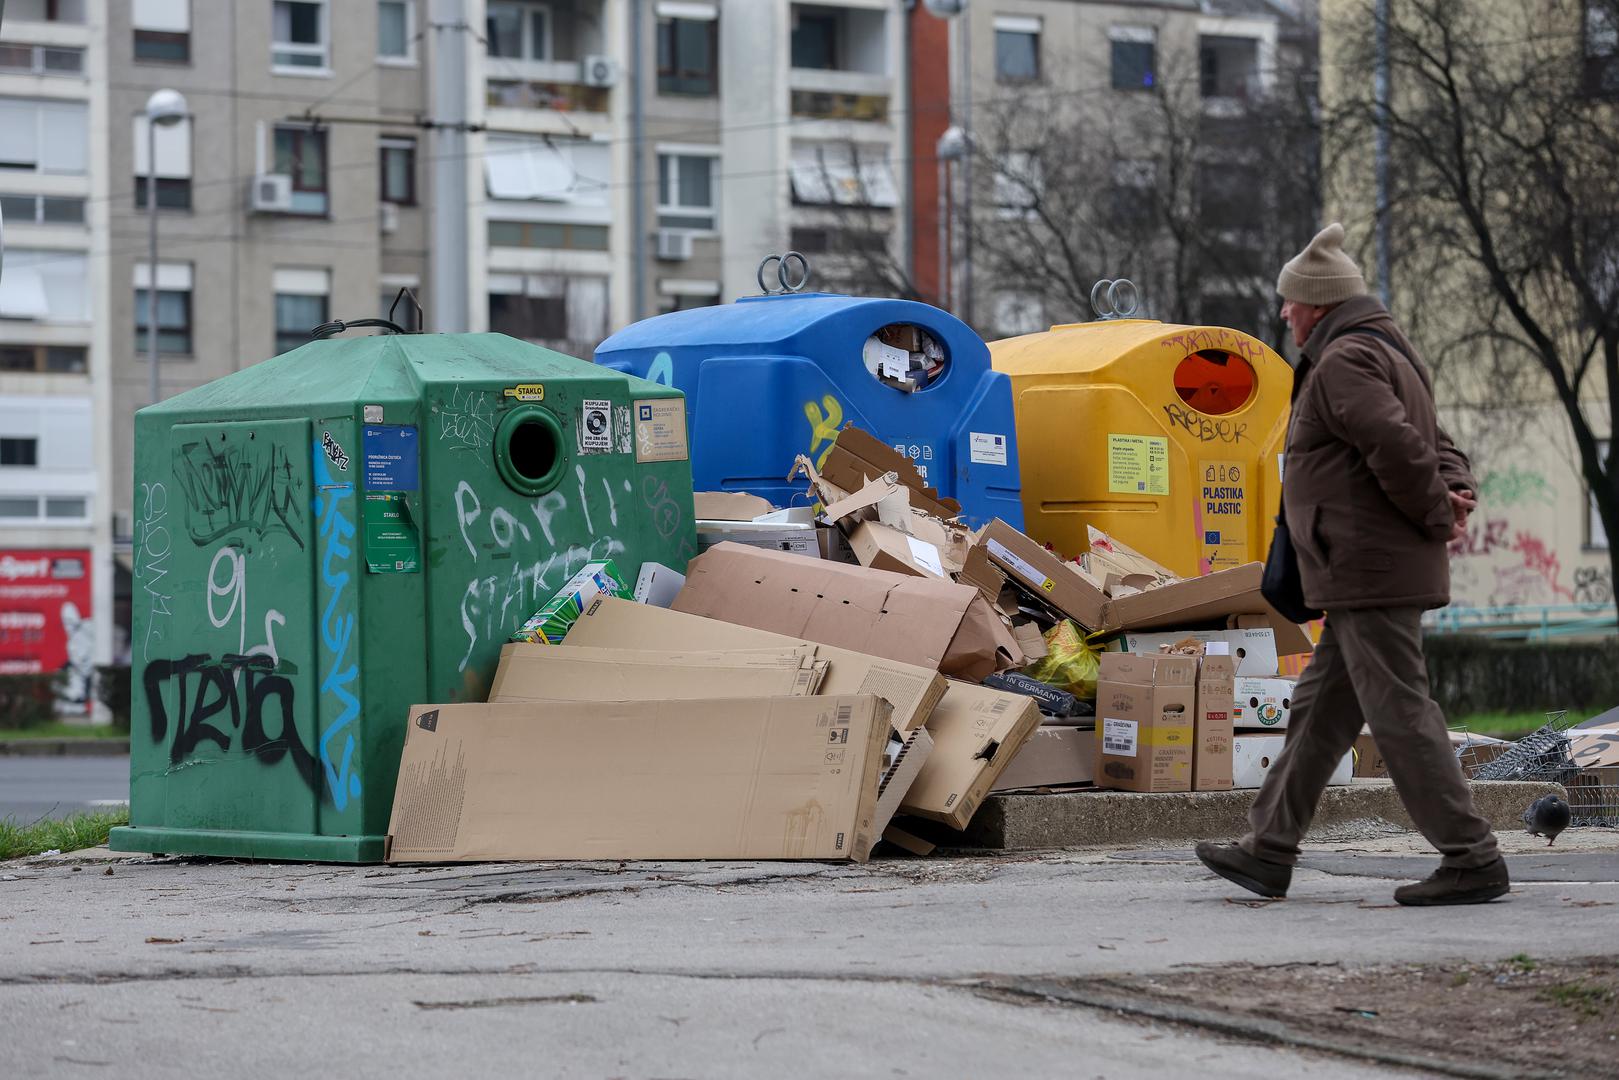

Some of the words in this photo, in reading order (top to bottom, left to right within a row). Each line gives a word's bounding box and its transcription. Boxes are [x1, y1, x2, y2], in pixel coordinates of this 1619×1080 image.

[518, 387, 542, 395] STAKLO
[1203, 487, 1244, 499] PLASTIKA
[1207, 502, 1241, 515] PLASTIC
[1045, 582, 1053, 590] 2
[1006, 675, 1017, 685] IN
[1018, 680, 1062, 703] GERMANY
